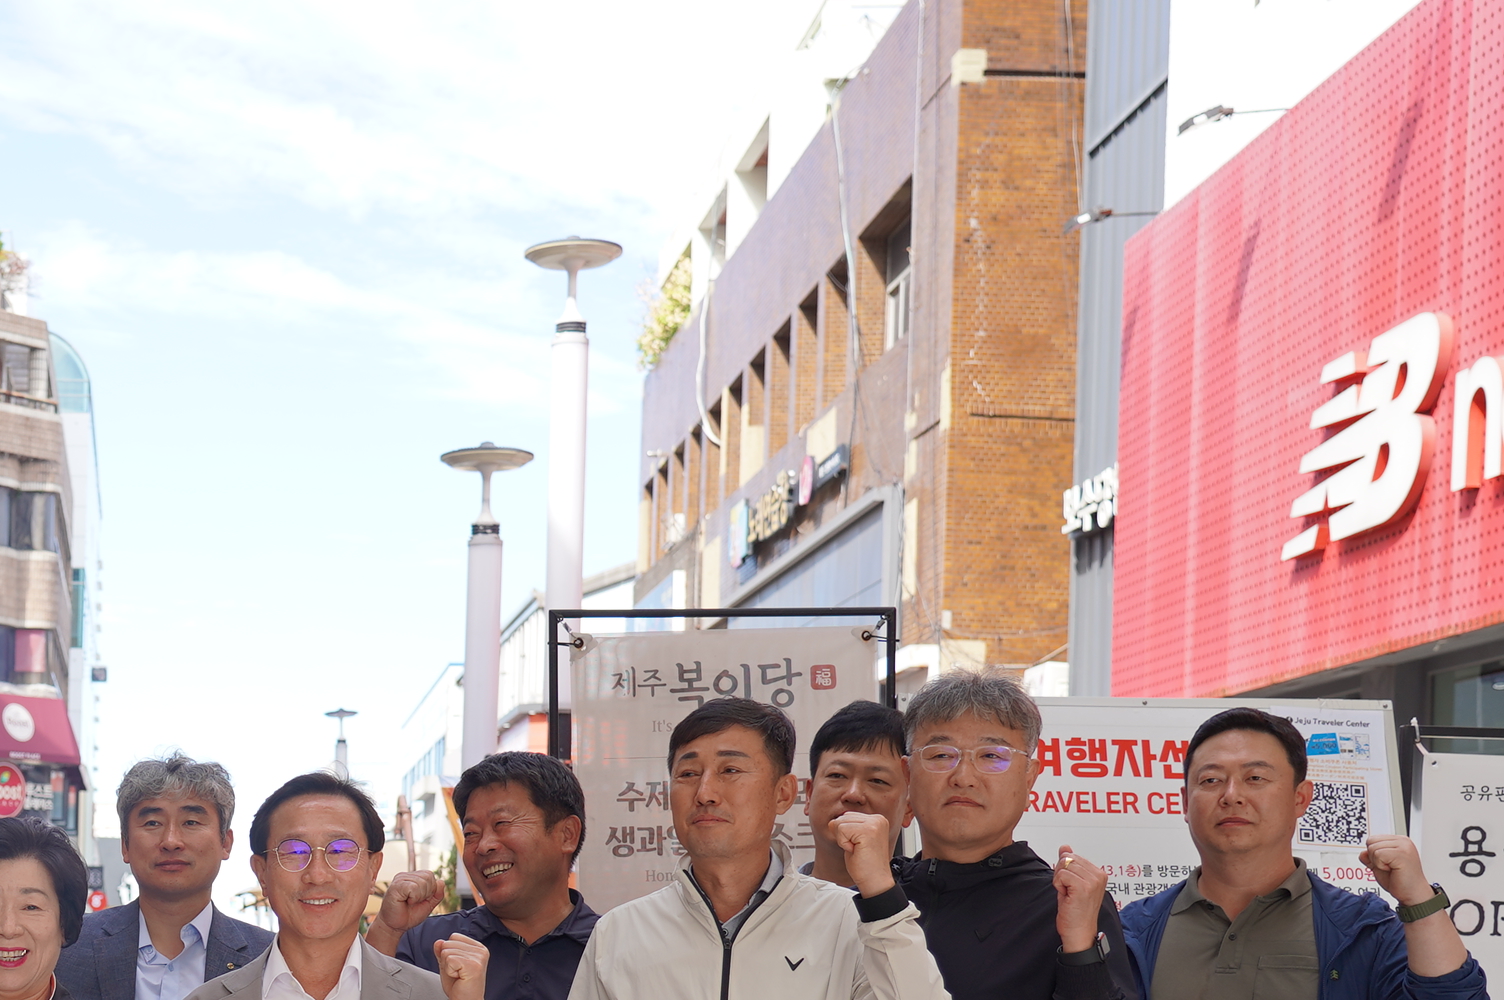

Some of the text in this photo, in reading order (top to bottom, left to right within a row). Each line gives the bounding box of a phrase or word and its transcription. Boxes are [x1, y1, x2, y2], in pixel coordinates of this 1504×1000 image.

[652, 719, 673, 733] It's
[1294, 717, 1371, 728] Jeju Traveler Center
[1147, 792, 1187, 815] CE
[1448, 826, 1497, 878] 용
[1157, 864, 1197, 878] 방문하
[1106, 882, 1130, 896] 국내
